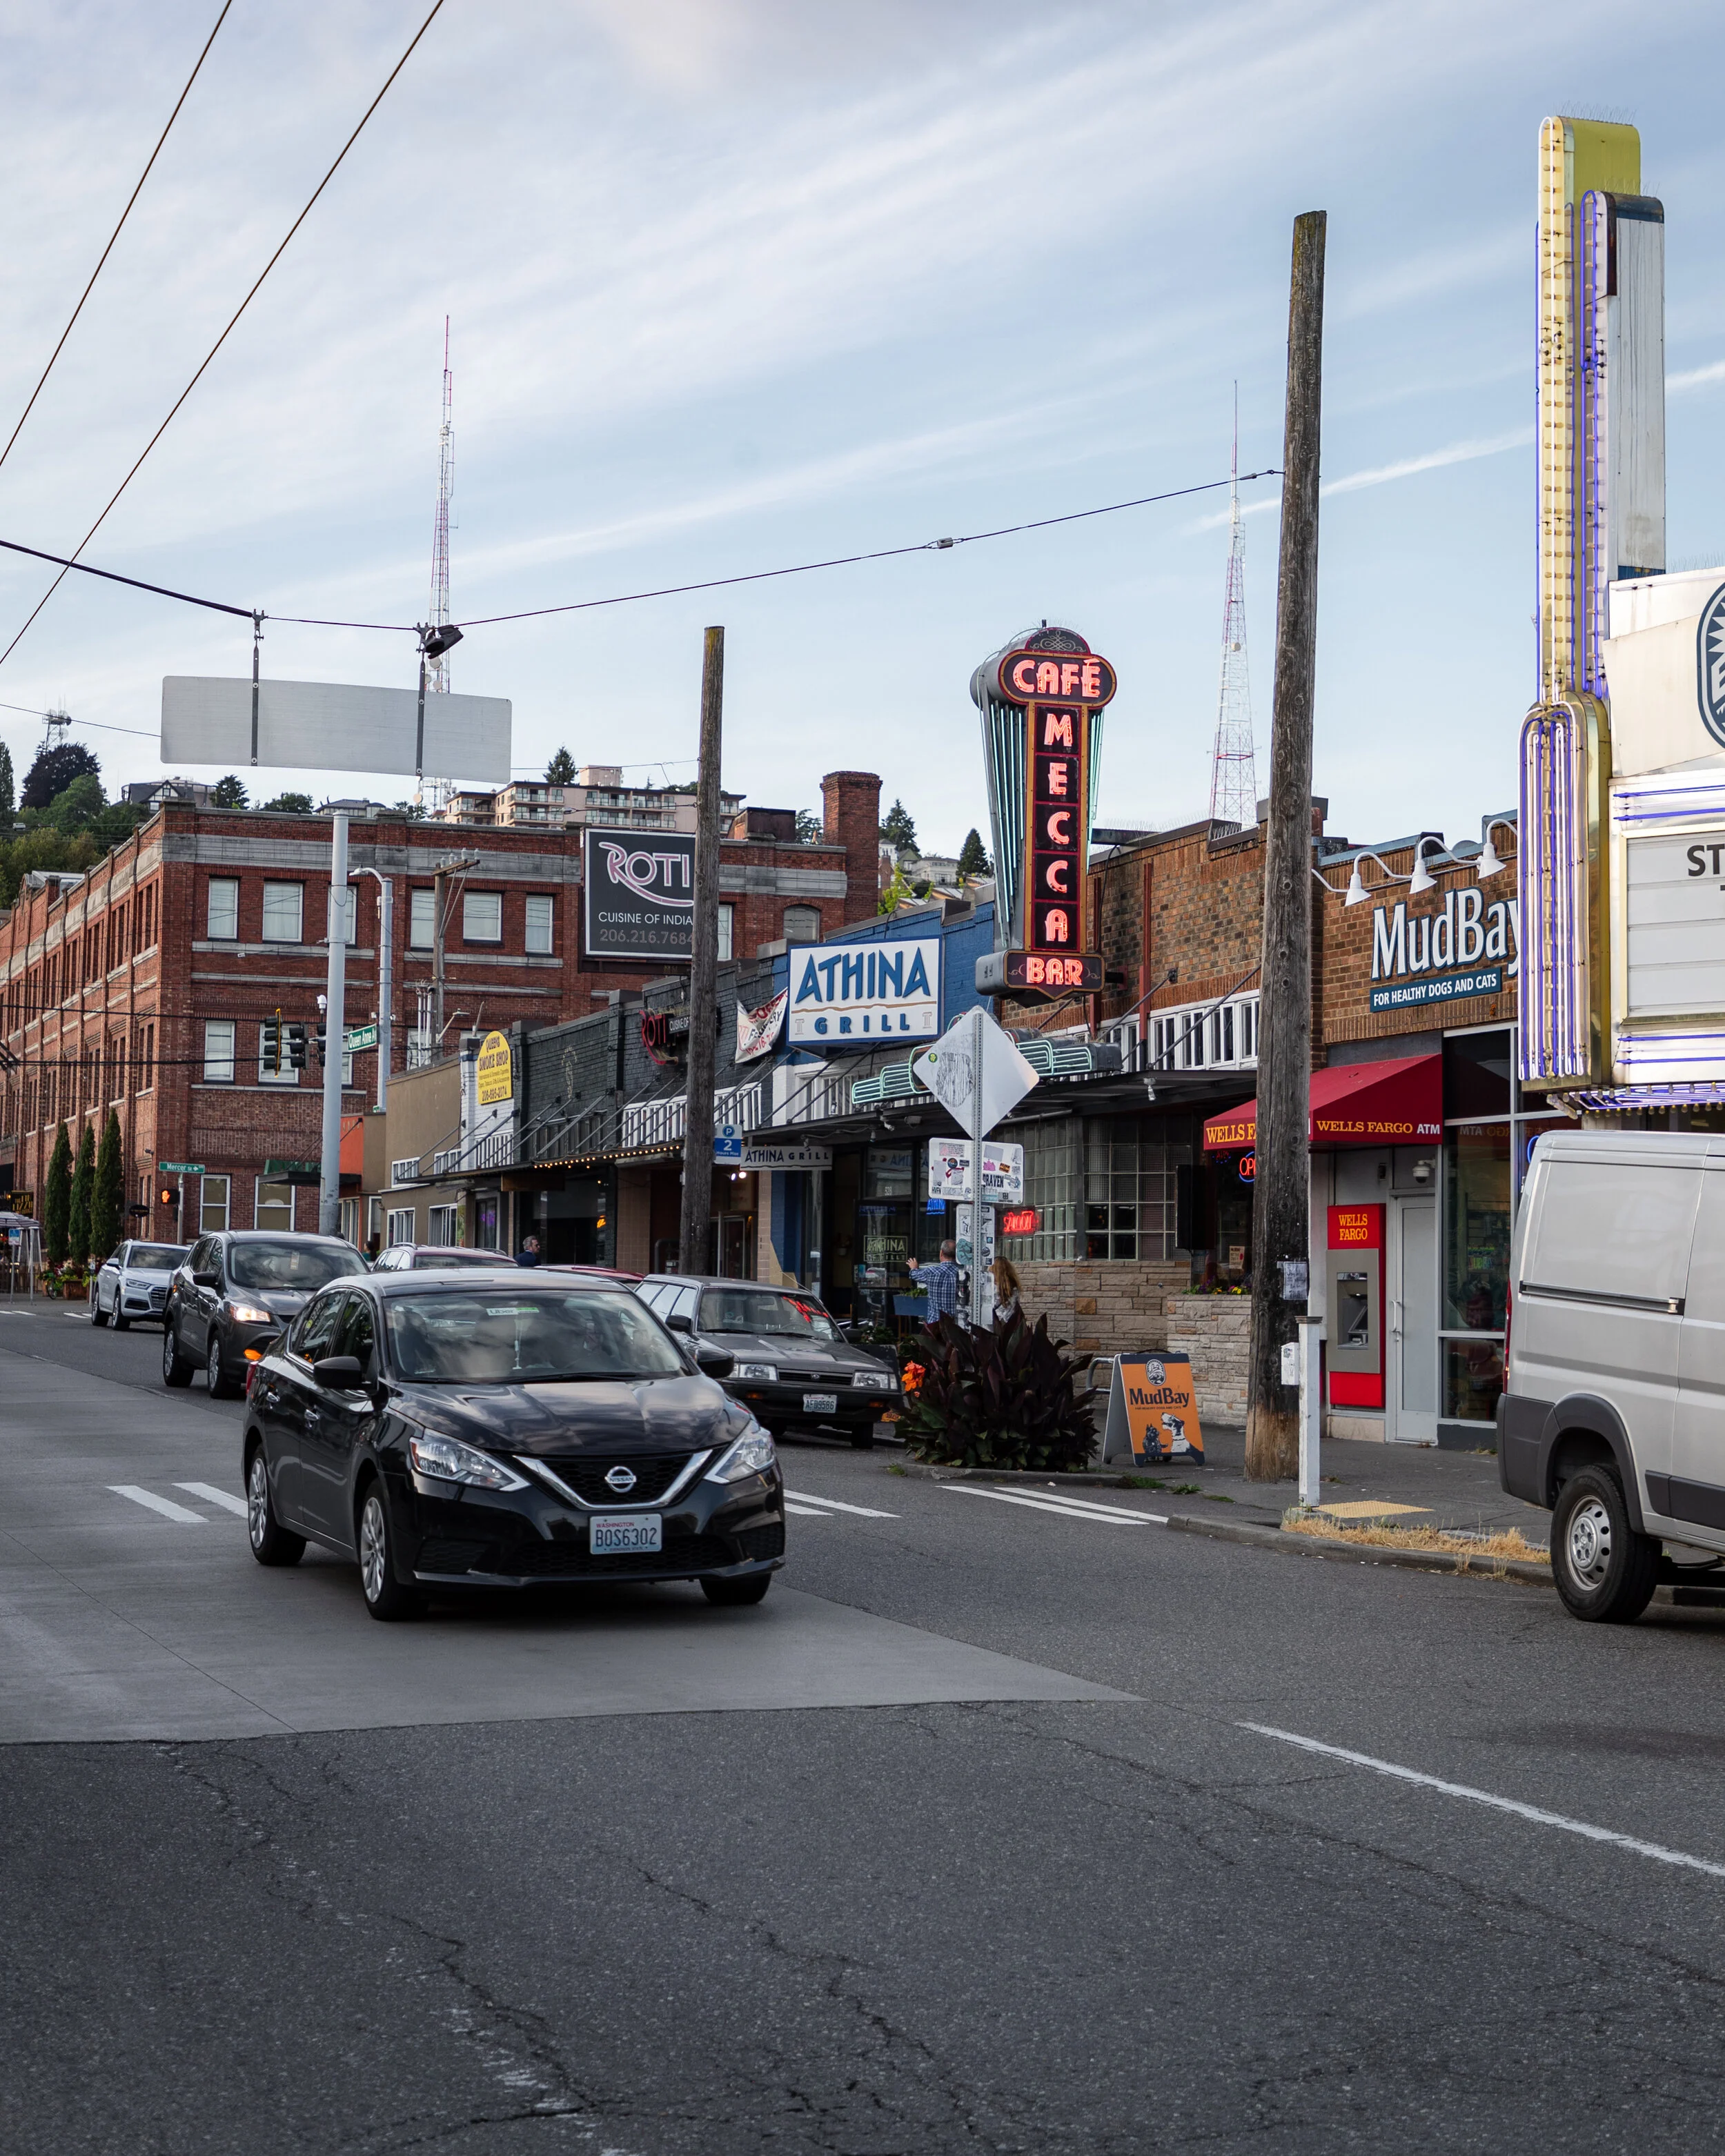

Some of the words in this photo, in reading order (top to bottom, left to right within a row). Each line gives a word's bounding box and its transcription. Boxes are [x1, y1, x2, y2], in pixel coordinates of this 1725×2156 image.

[1012, 657, 1101, 698] CAFÉ
[1043, 713, 1074, 942] MECCA
[598, 841, 694, 907] ROTI
[598, 911, 642, 923] CUISINE
[644, 913, 660, 924] OF
[663, 914, 693, 925] INDIA
[599, 928, 693, 945] 206.216.7684
[1371, 887, 1518, 978] MudBay
[795, 946, 931, 1004] ATHINA
[1025, 958, 1083, 987] BAR
[1373, 992, 1390, 1007] FOR
[1391, 985, 1427, 1005] HEALTHY
[1428, 981, 1452, 997] DOGS
[1455, 977, 1474, 993] AND
[1475, 973, 1497, 989] CATS
[814, 1013, 909, 1034] GRILL
[348, 1034, 362, 1049] Queen
[362, 1030, 371, 1045] Anne
[639, 1009, 666, 1065] ROTI
[479, 1054, 495, 1071] SMOKE
[496, 1049, 509, 1067] SHOP
[1205, 1123, 1245, 1143] WELLS
[1316, 1120, 1364, 1132] WELLS
[1367, 1121, 1413, 1134] FARGO
[1417, 1123, 1440, 1134] ATM
[723, 1139, 732, 1151] 2
[745, 1149, 784, 1163] ATHINA
[788, 1151, 829, 1160] GRILL
[1239, 1157, 1256, 1176] OP
[1339, 1214, 1368, 1226] WELLS
[1339, 1228, 1368, 1240] FARGO
[1130, 1387, 1190, 1407] MudBay
